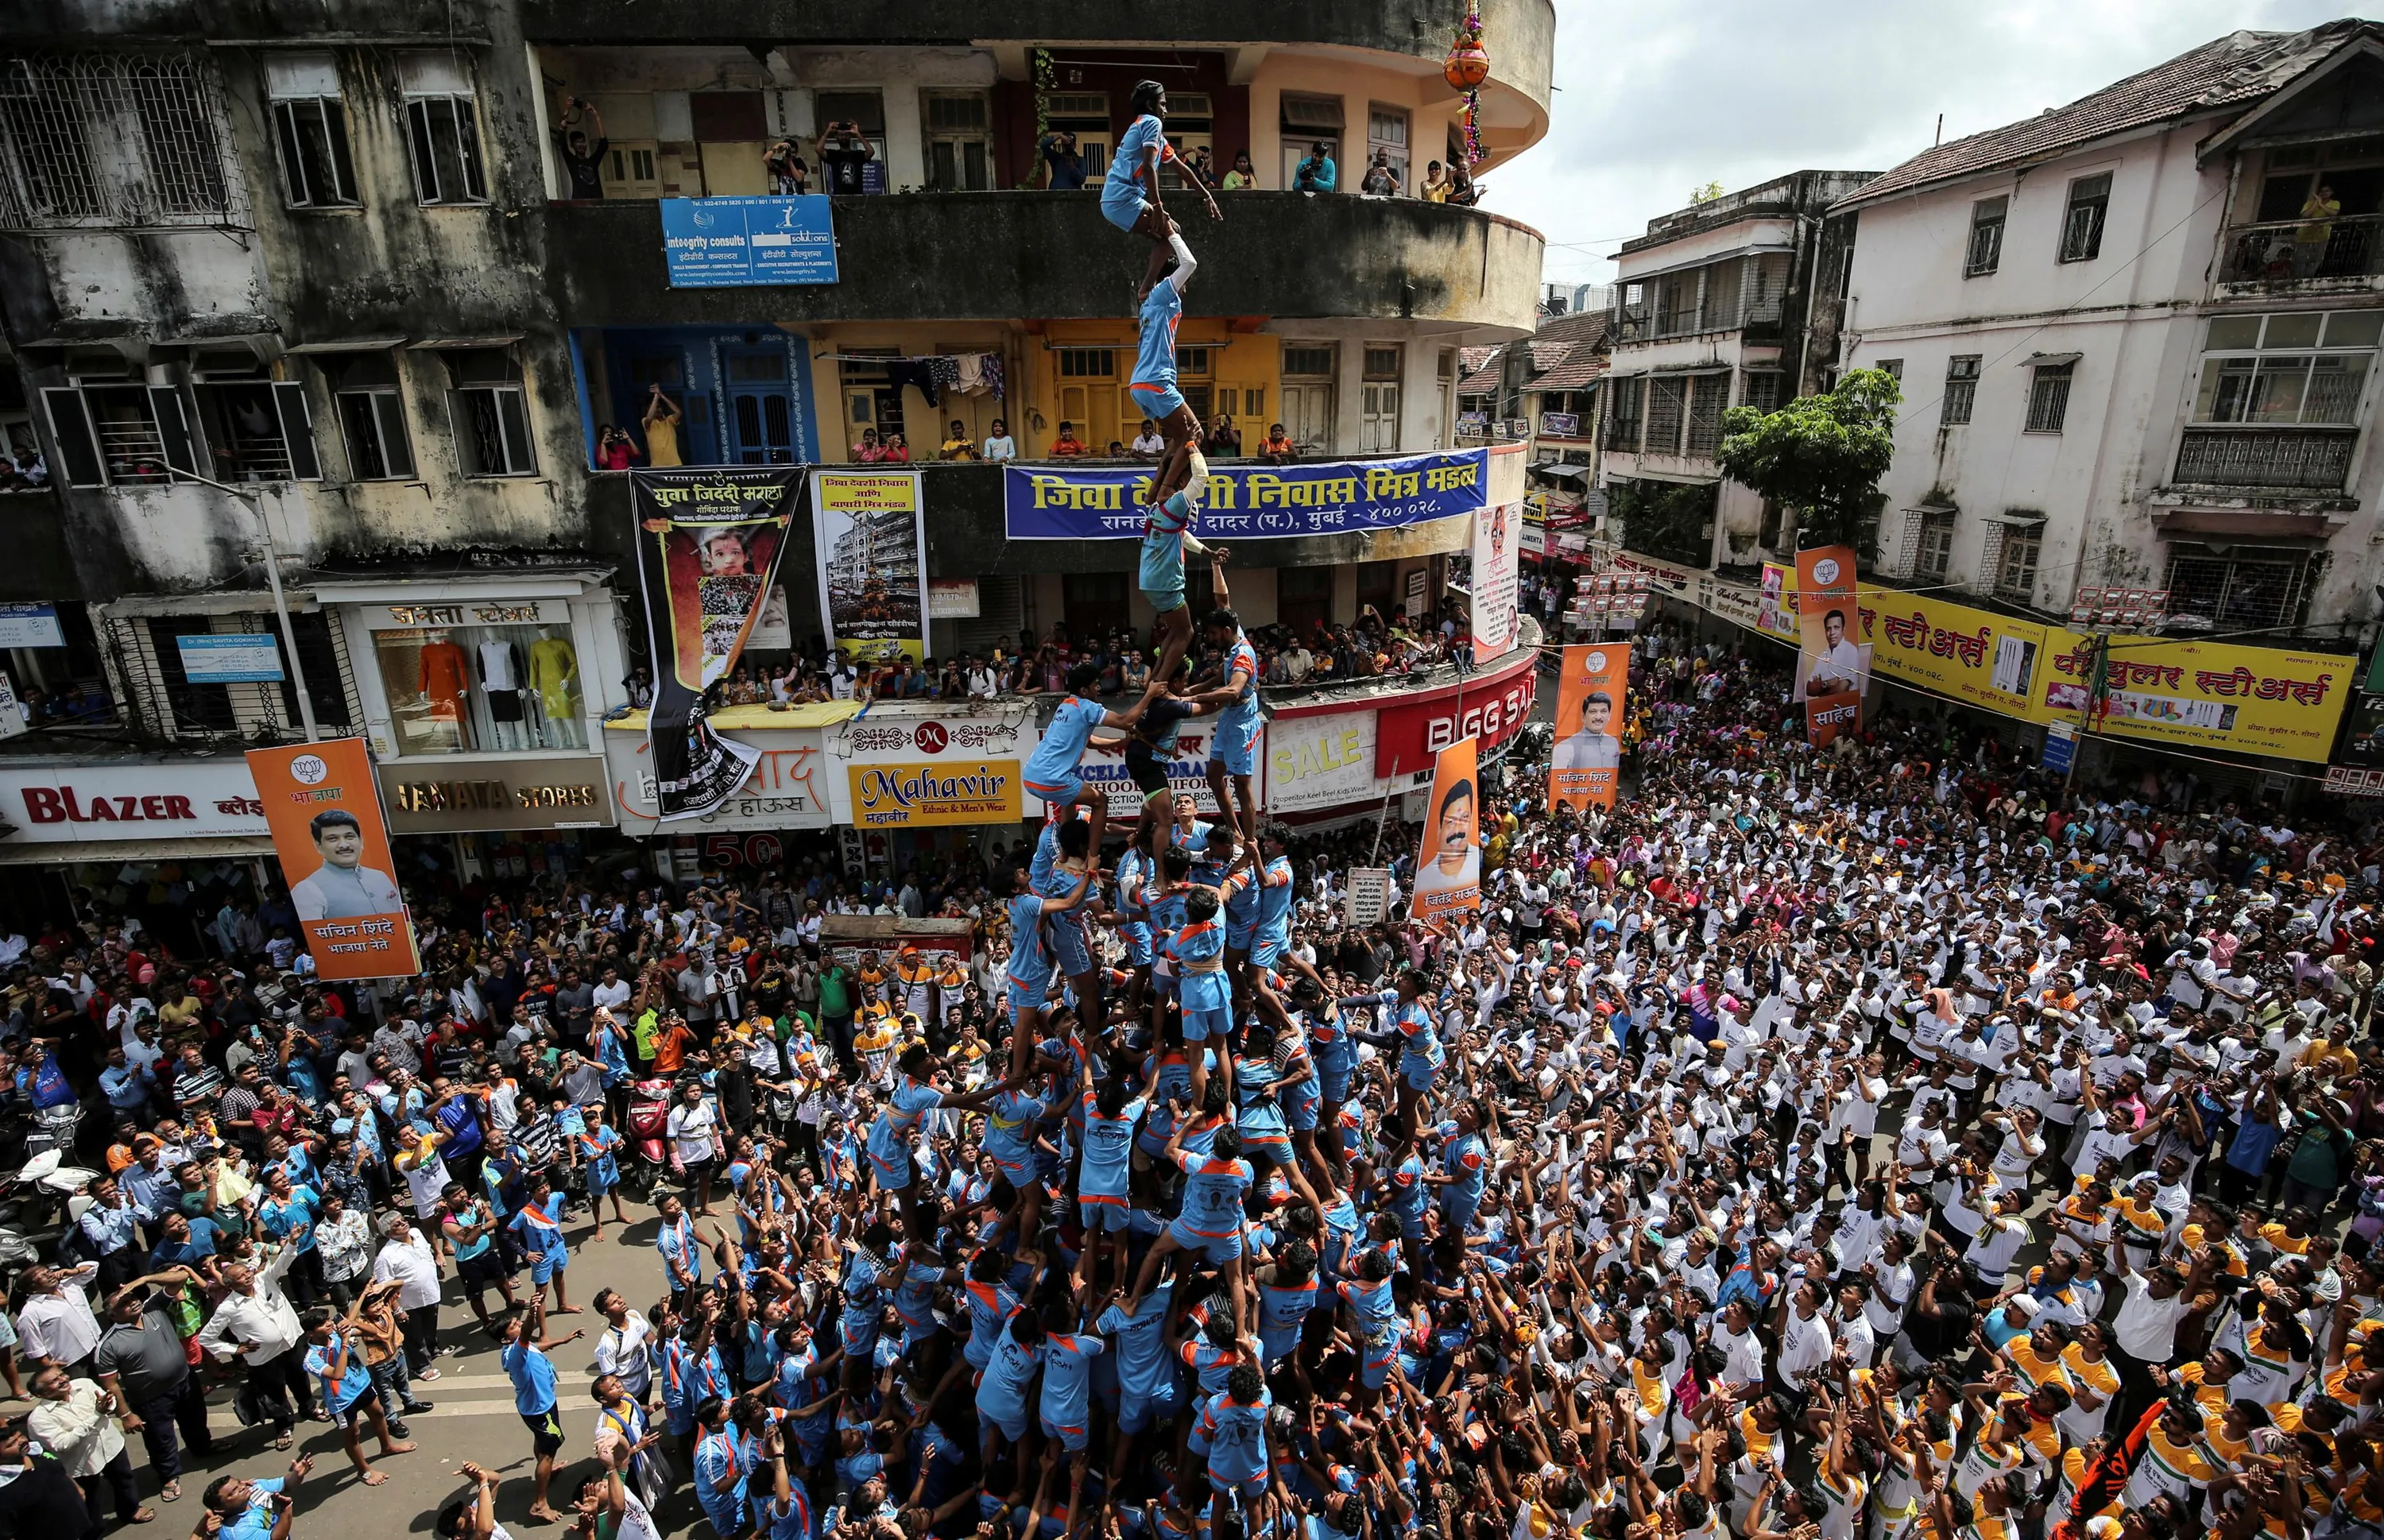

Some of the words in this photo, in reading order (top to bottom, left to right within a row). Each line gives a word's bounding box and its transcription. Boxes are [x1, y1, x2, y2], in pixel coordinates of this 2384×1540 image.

[710, 234, 745, 246] consults
[1031, 475, 1124, 509] जिवा
[1246, 474, 1358, 509] निवास
[1364, 468, 1420, 502] मित्र
[1426, 456, 1480, 493] मंडळ
[653, 488, 689, 508] युवा
[1205, 516, 1251, 532] दादर
[1307, 504, 1347, 530] मुंबई
[1367, 506, 1403, 520] ४००
[389, 605, 463, 625] जनता
[471, 602, 540, 624] स्टोअर्स
[702, 617, 714, 628] 2018
[702, 656, 715, 667] 2019
[1887, 655, 1902, 669] मुंबई
[1579, 676, 1609, 686] भाजपा
[1980, 687, 1997, 702] सुधीर
[2008, 696, 2027, 711] गोगटे
[1814, 703, 1857, 726] साहेब
[917, 728, 946, 747] M
[2269, 726, 2288, 735] सुधीर
[2301, 729, 2321, 739] गोगटे
[1272, 729, 1362, 785] SALE
[861, 765, 1006, 809] Mahavir
[1558, 772, 1587, 784] सचिन
[1589, 771, 1612, 784] शिंदे
[290, 787, 343, 804] भाजपा
[395, 779, 514, 812] JANATA
[517, 784, 596, 808] STORES
[1591, 784, 1604, 795] नेते
[21, 785, 197, 824] BLAZER
[739, 797, 805, 817] हाऊस
[923, 803, 949, 814] Ethnic
[950, 803, 959, 813] &
[961, 803, 984, 813] Men's
[985, 802, 1006, 812] Wear
[865, 807, 910, 825] महावीर
[1424, 888, 1453, 907] जितेंद्र
[1453, 884, 1479, 902] राऊत
[312, 923, 358, 938] सचिन
[361, 918, 395, 937] शिंदे
[327, 942, 368, 954] भाजपा
[370, 938, 389, 952] नेते
[722, 985, 739, 994] Jeep
